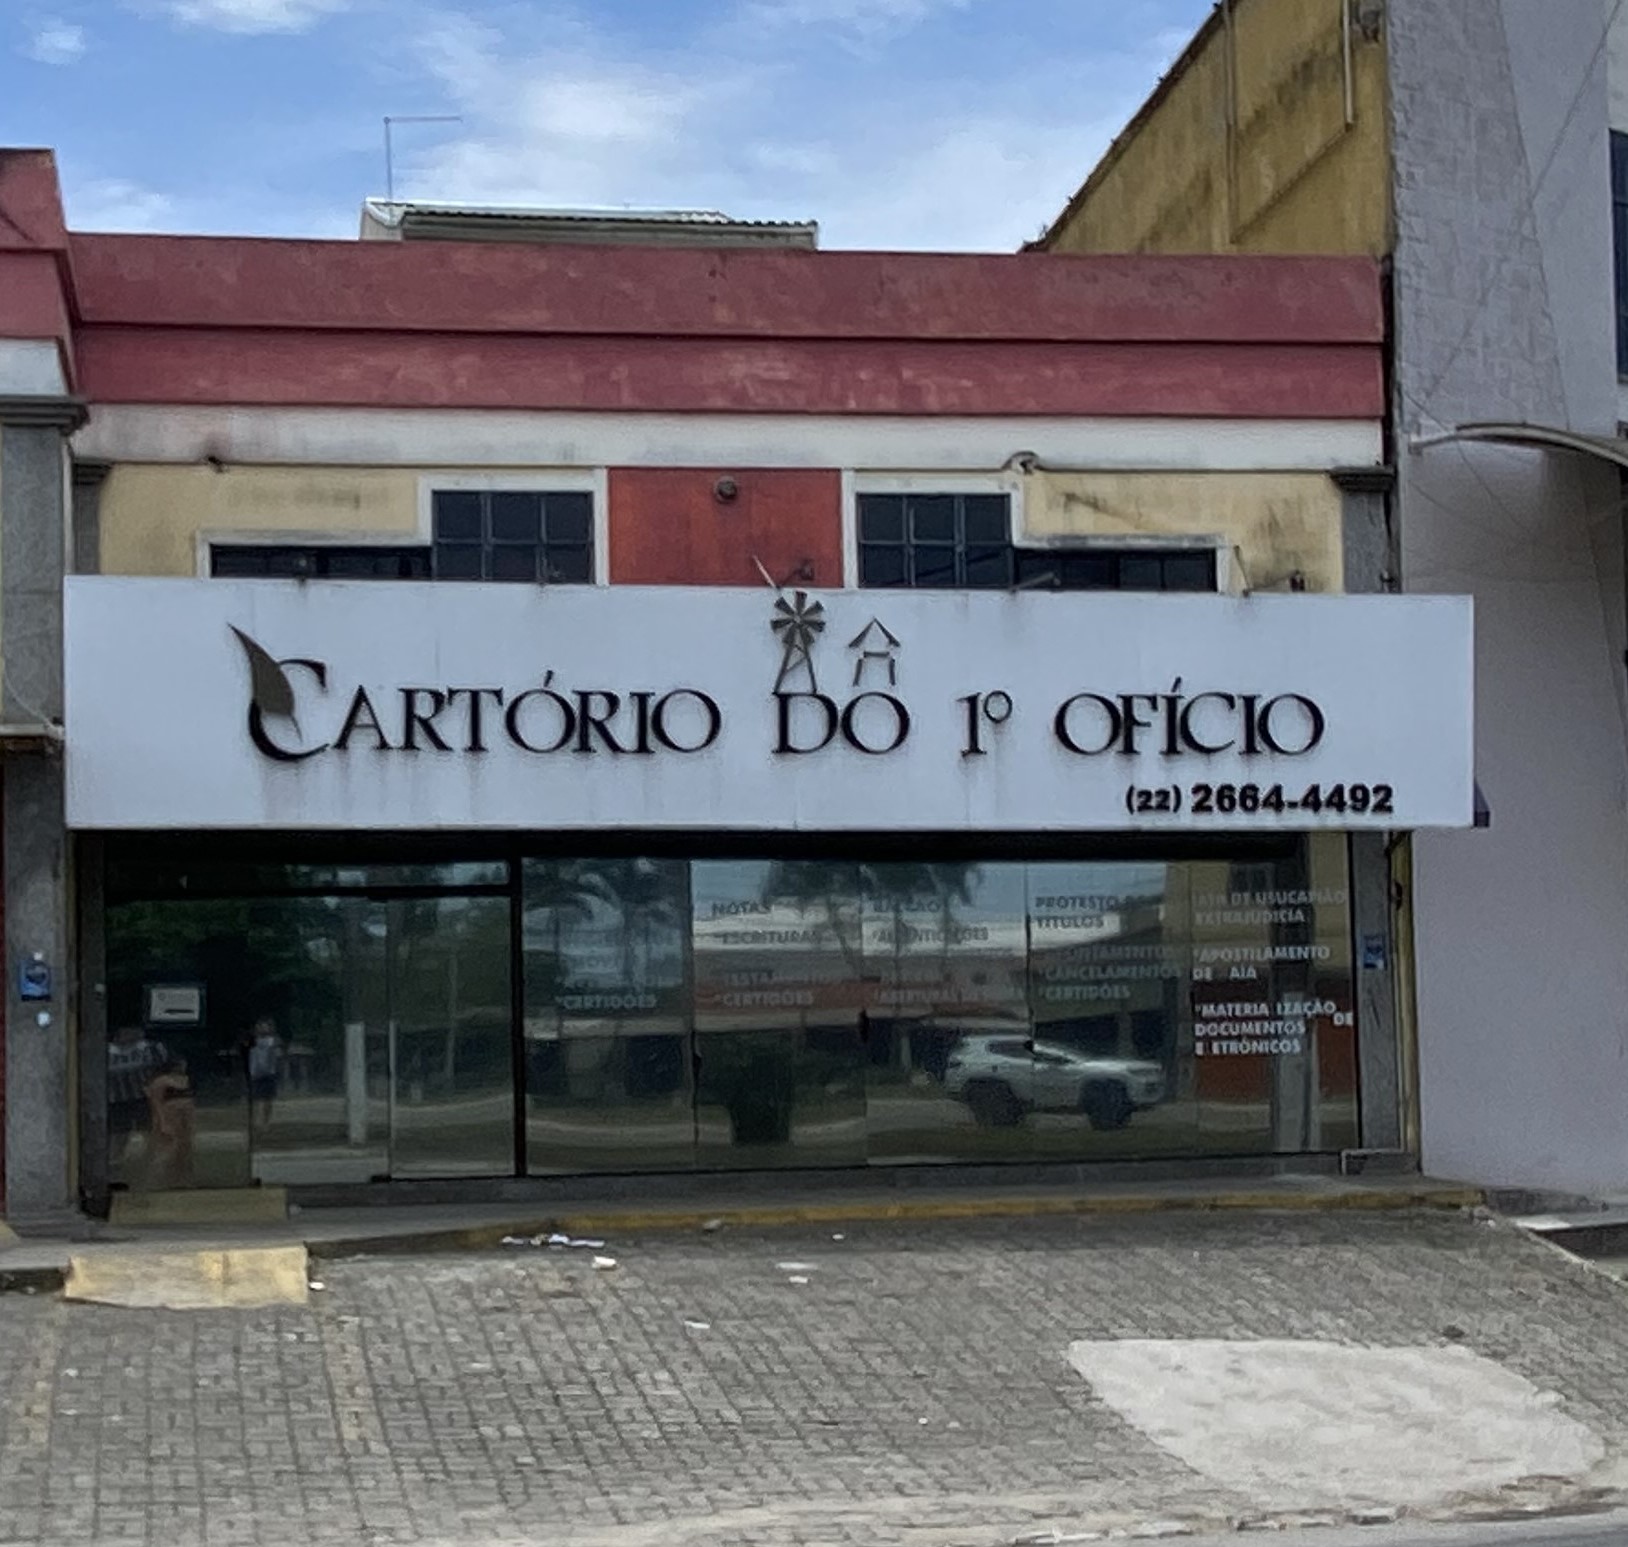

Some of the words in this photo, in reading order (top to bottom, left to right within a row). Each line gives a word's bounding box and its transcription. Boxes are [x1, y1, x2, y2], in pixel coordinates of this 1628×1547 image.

[248, 658, 722, 762] CARTÓRIO
[772, 691, 910, 755] DO
[1053, 677, 1326, 756] OFÍCIO
[1125, 784, 1182, 815] (22)
[1190, 783, 1394, 814] 2664-4492
[1034, 895, 1120, 911] PROTESTO
[1192, 966, 1212, 981] DE
[1194, 1018, 1307, 1037] DOCUMENTOS
[1333, 1011, 1354, 1027] DE
